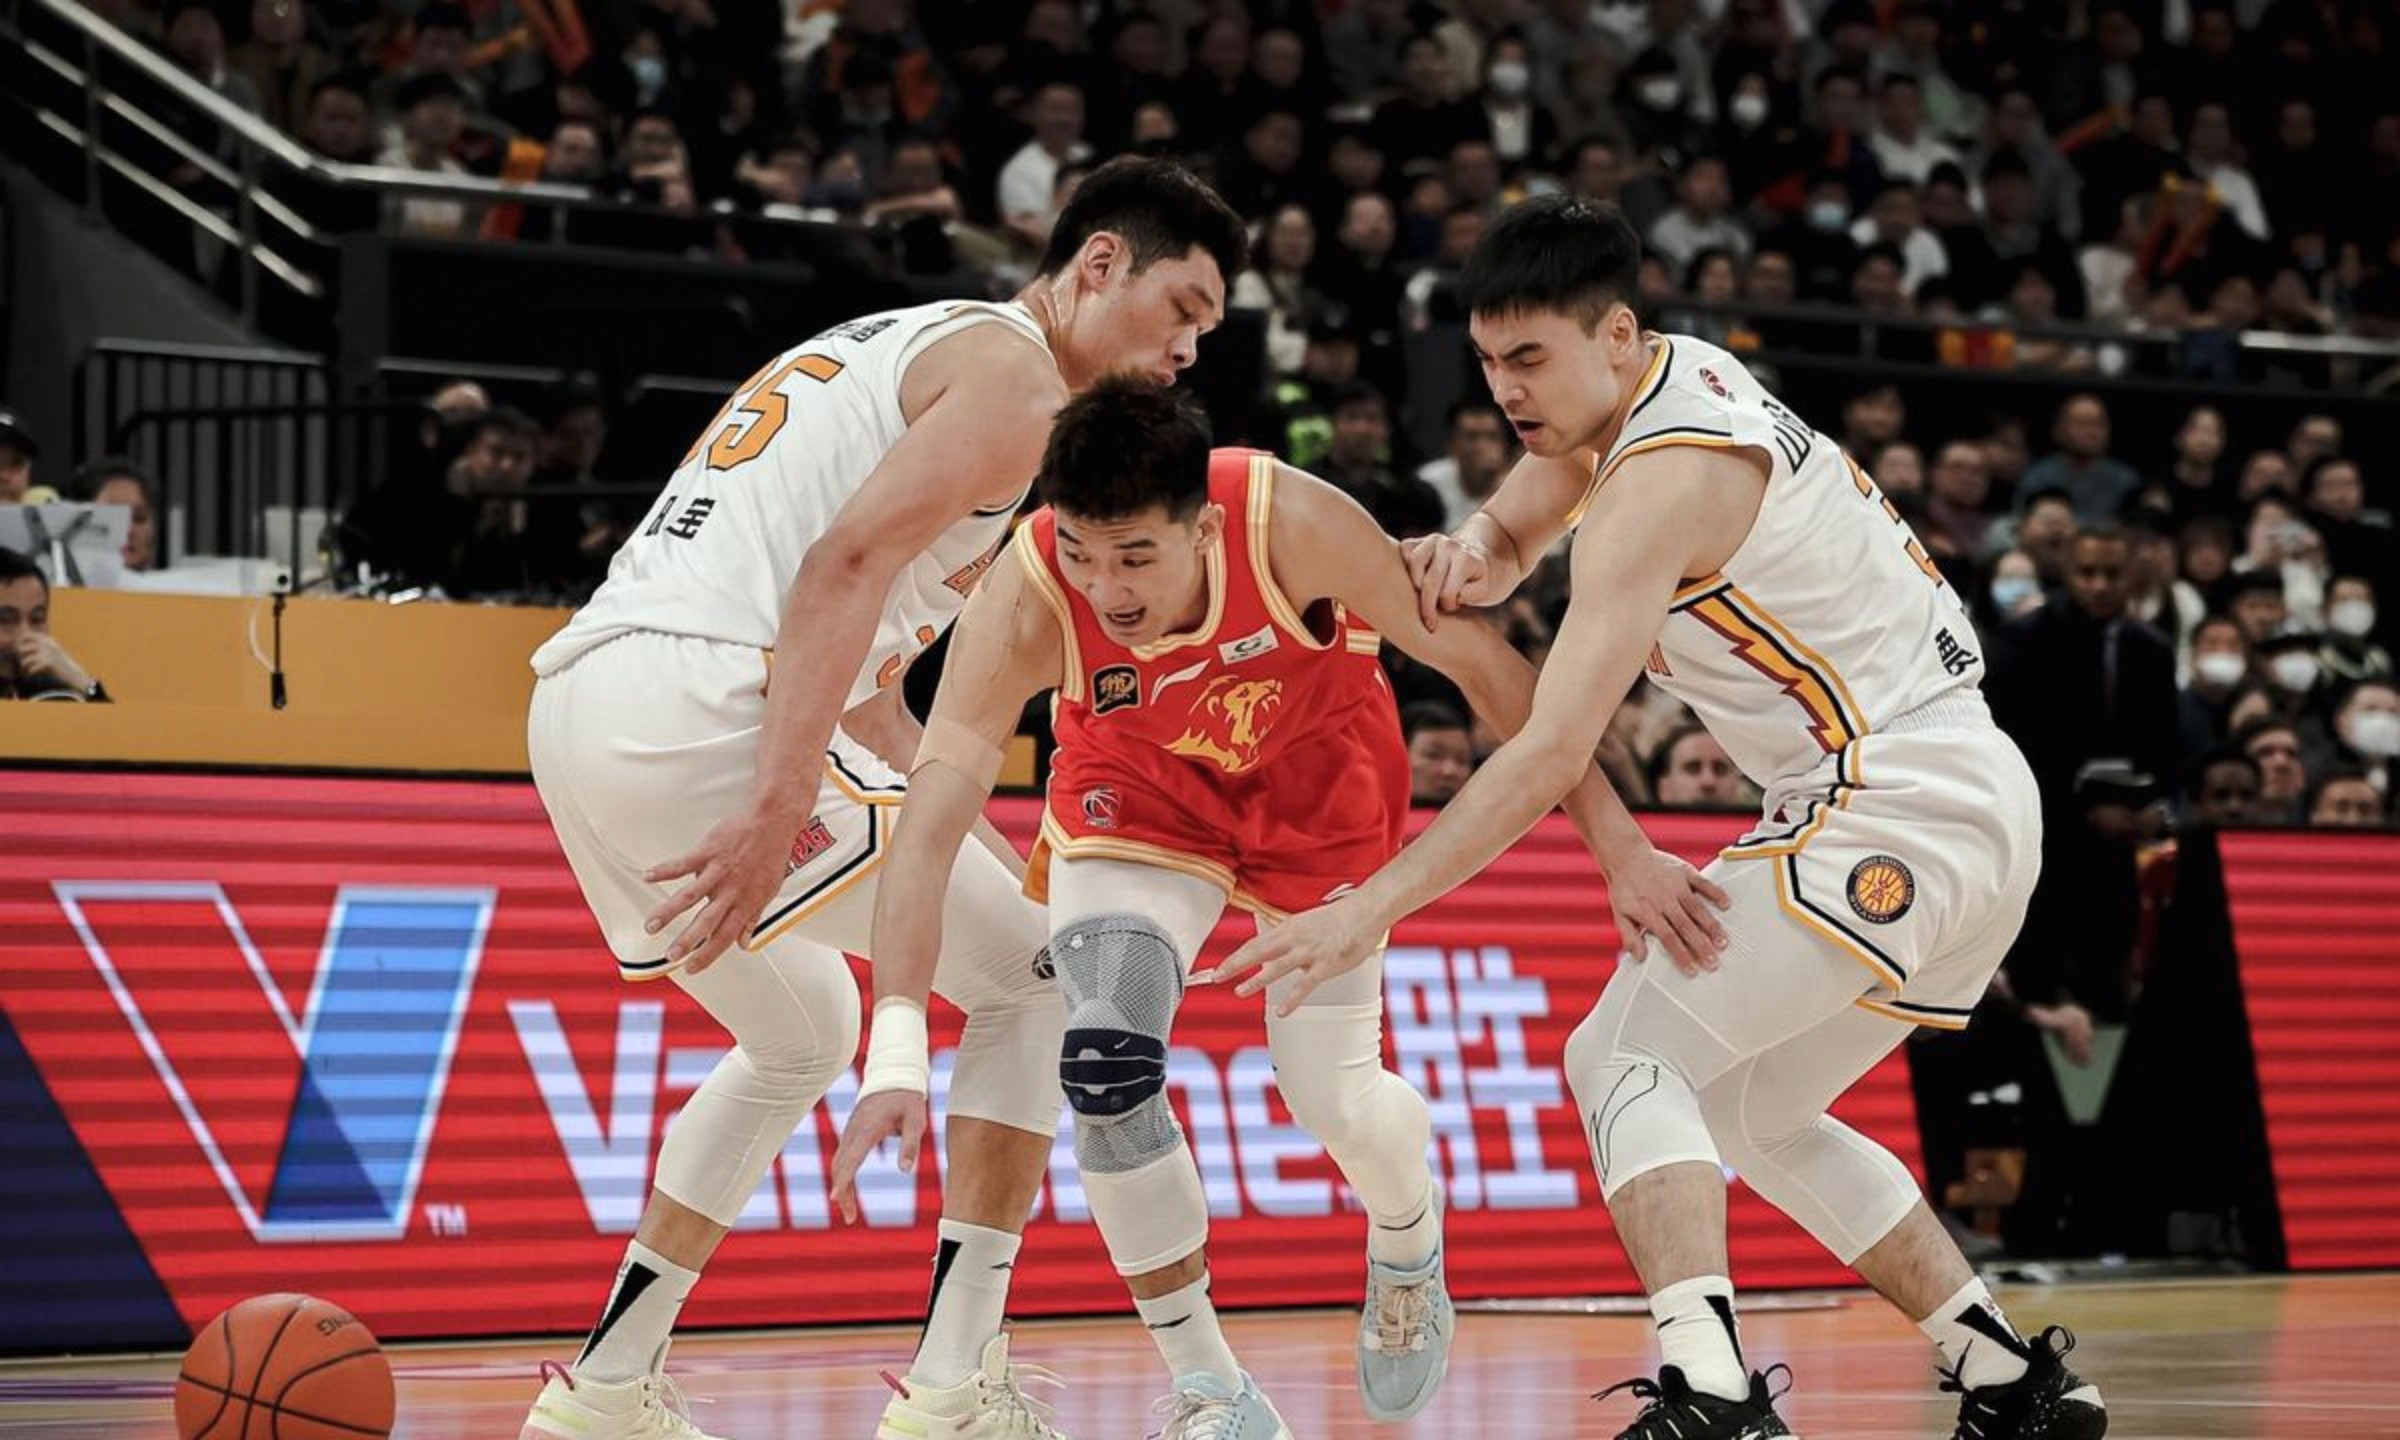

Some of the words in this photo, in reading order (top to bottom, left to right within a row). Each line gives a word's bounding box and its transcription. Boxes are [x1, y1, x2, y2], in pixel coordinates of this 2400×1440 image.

[679, 353, 846, 471] 5
[644, 495, 717, 540] 宝
[1382, 945, 1582, 1210] 胜
